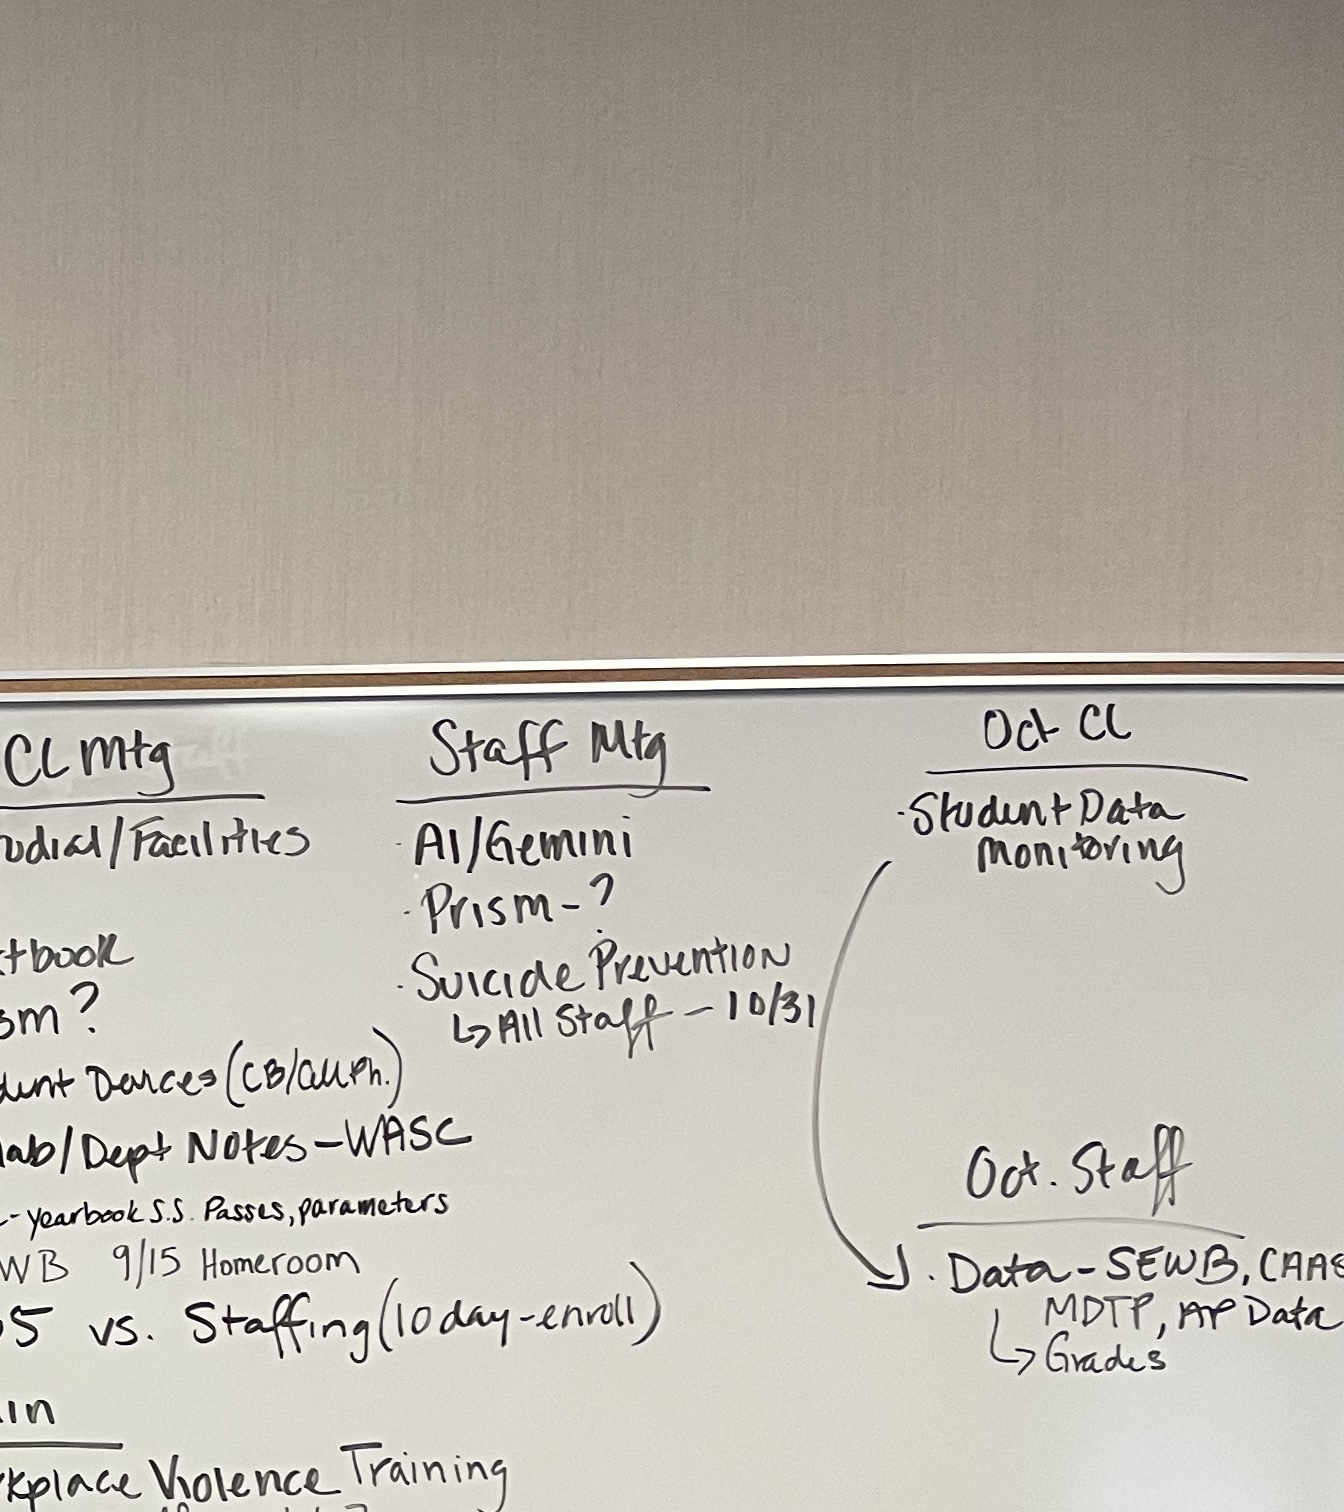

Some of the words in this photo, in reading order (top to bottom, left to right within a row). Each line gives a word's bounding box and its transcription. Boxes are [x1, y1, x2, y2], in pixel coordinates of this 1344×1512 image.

[429, 718, 569, 781] Staff
[909, 791, 1072, 835] Student
[1080, 787, 1186, 827] Data
[411, 952, 587, 1002] Suicide
[589, 936, 792, 991] Prevention
[499, 1008, 543, 1045] All
[556, 993, 673, 1059] Staff
[1072, 1123, 1193, 1217] Staff
[111, 1238, 181, 1289] 9/15
[202, 1247, 360, 1280] Homeroom
[89, 1320, 155, 1348] vs.
[1177, 1296, 1237, 1331] AP
[1248, 1294, 1343, 1331] Data
[1045, 1331, 1166, 1374] Grades
[148, 1454, 342, 1504] Violence
